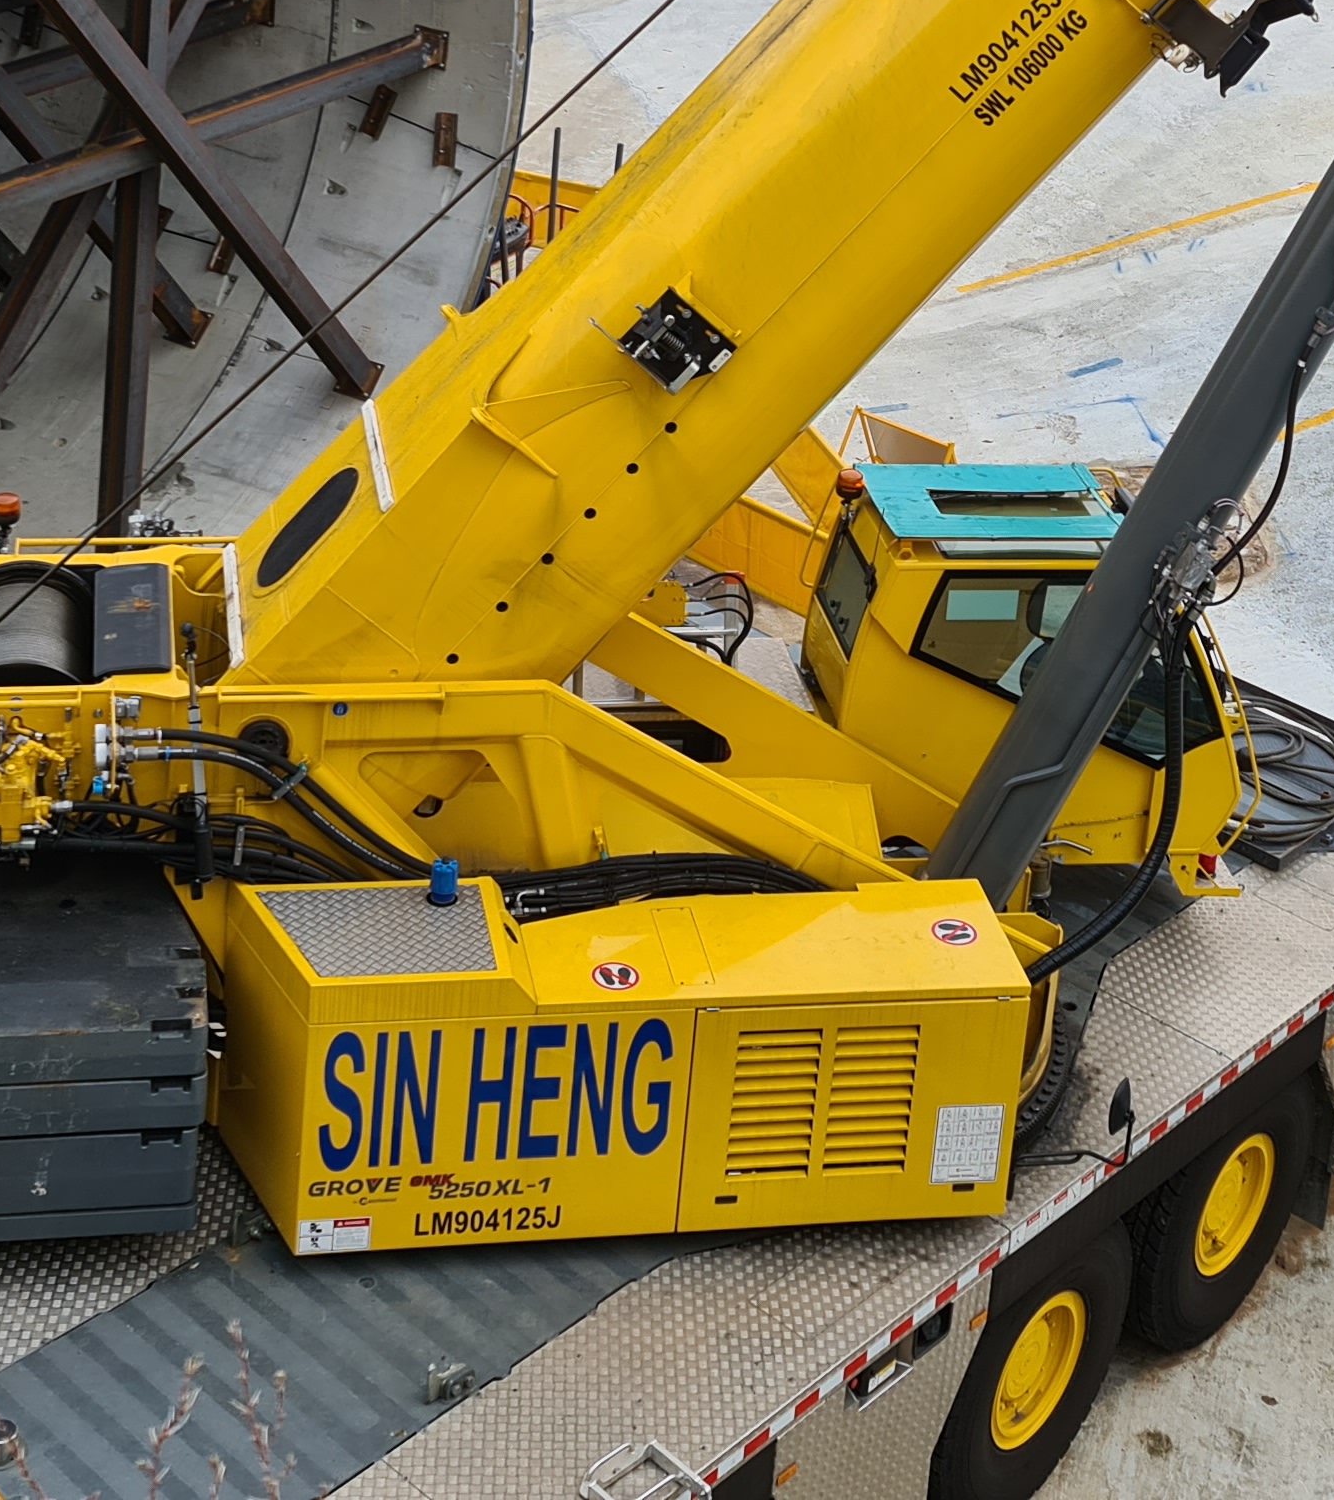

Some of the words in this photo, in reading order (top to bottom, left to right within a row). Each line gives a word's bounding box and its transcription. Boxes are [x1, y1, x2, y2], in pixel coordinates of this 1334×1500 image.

[974, 89, 1016, 127] SWL
[1006, 33, 1065, 92] 106000
[1056, 9, 1088, 42] KG
[317, 1029, 443, 1172] SIN
[465, 1017, 674, 1163] HENG
[308, 1176, 403, 1198] GROVE
[414, 1204, 562, 1237] LM904125J
